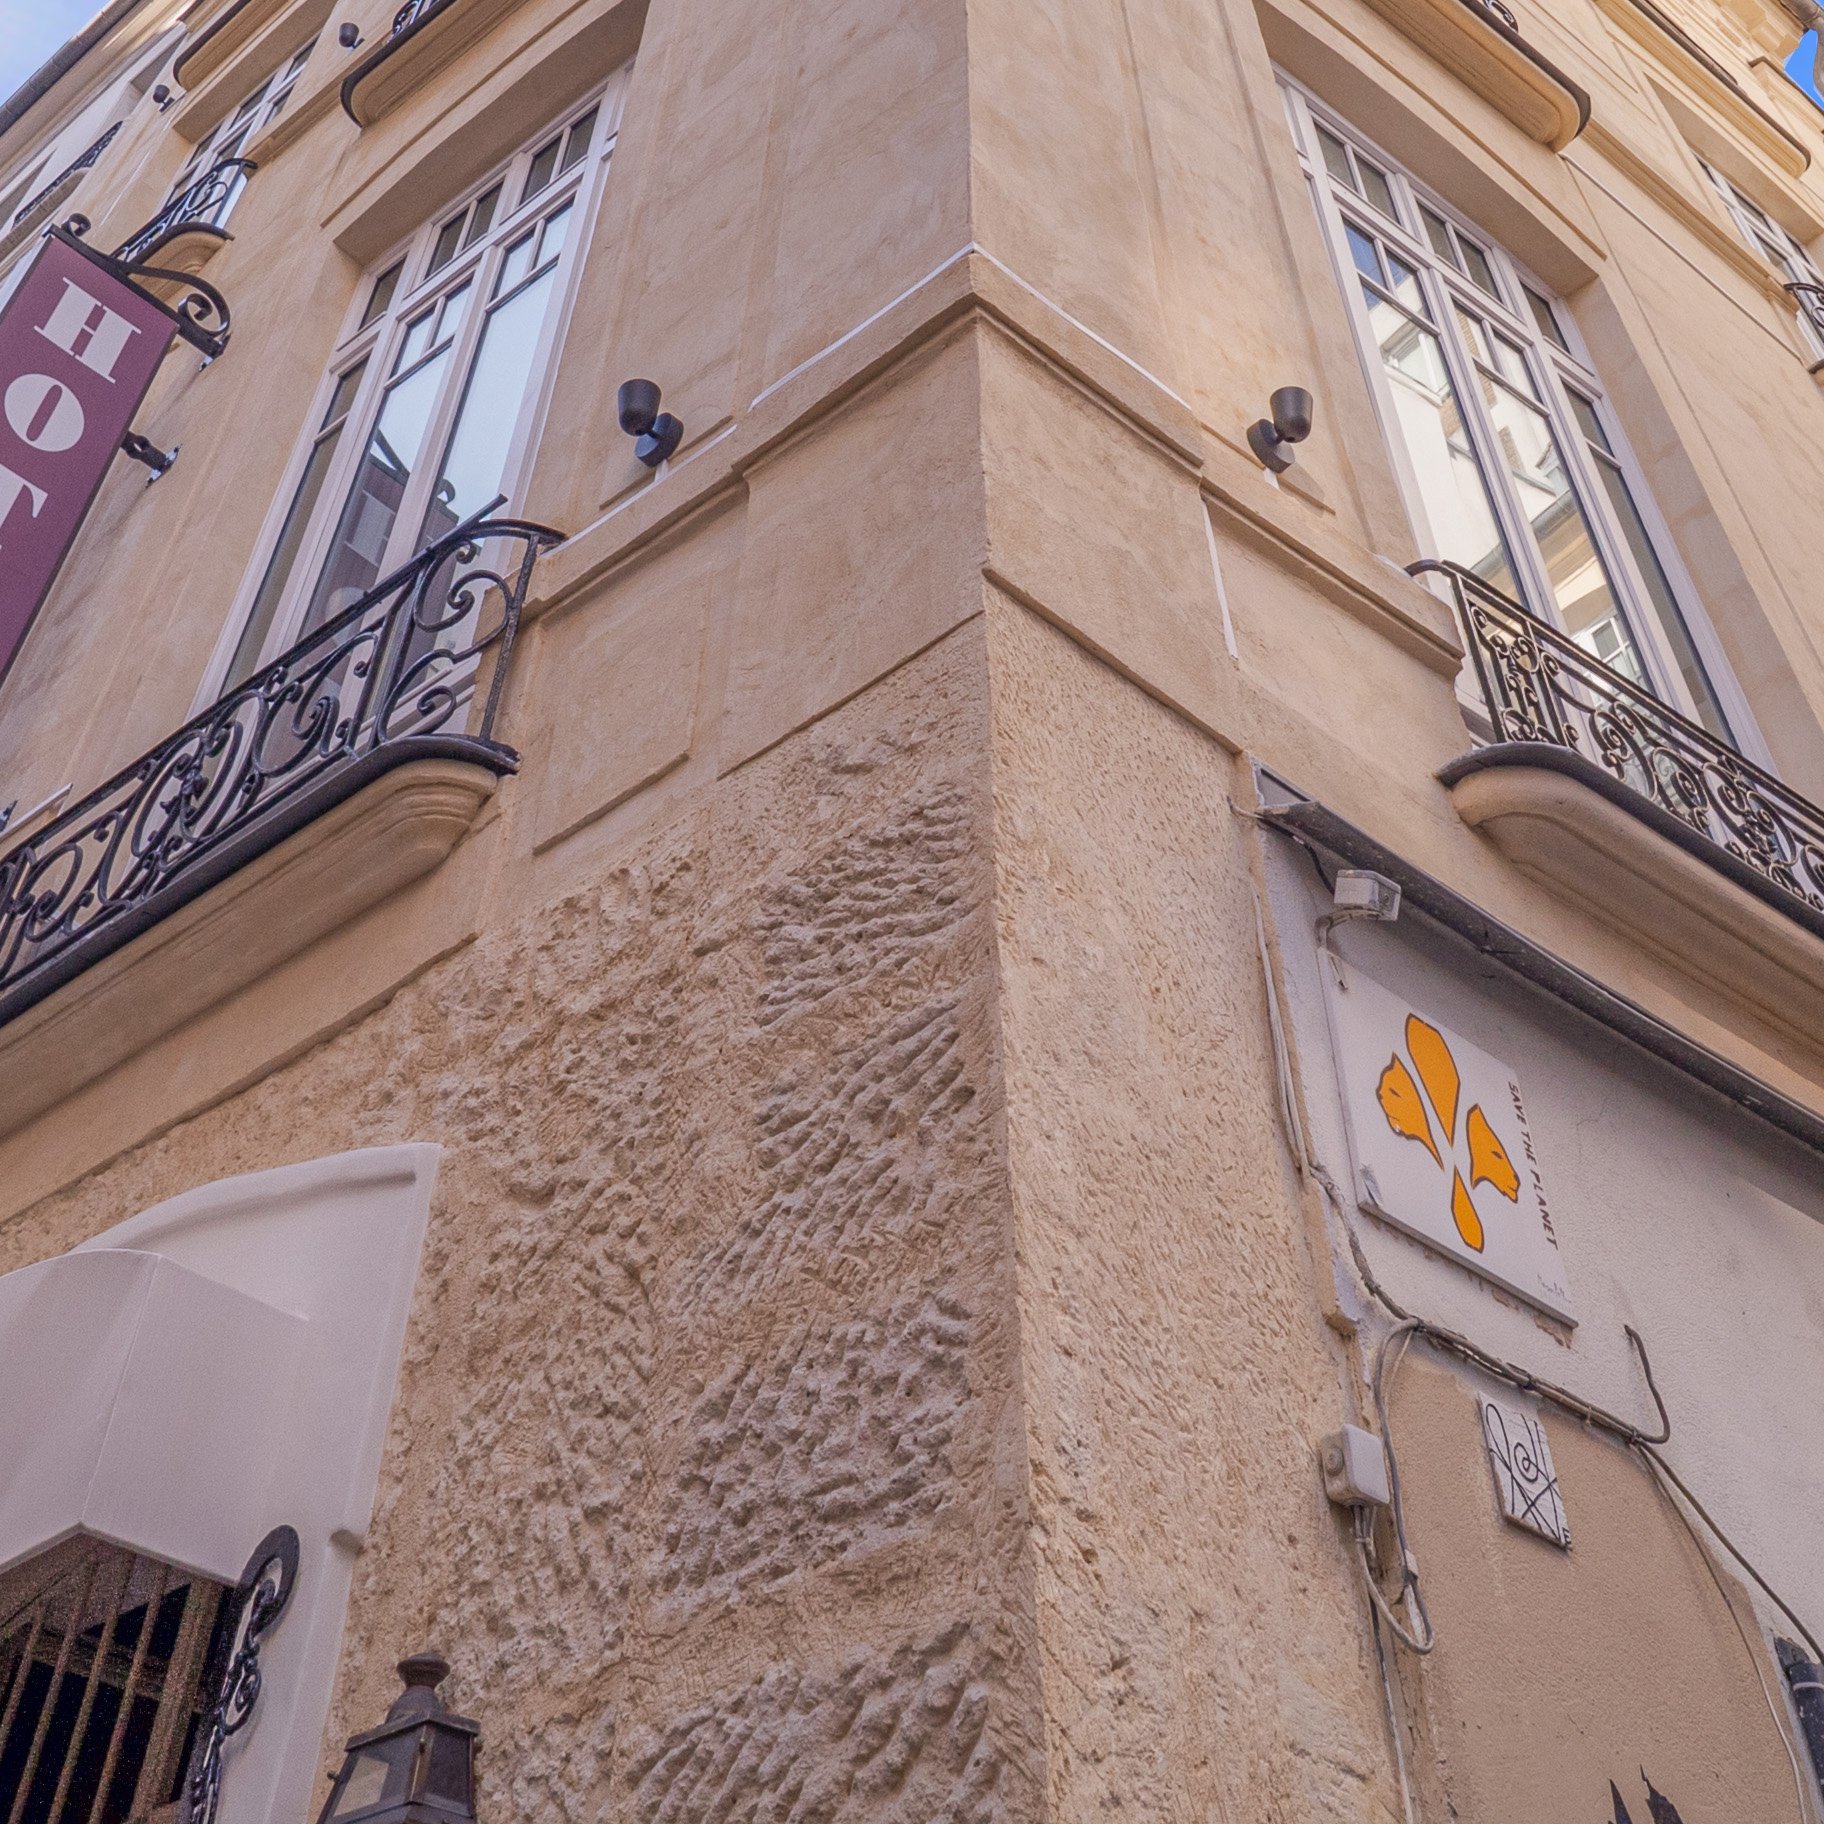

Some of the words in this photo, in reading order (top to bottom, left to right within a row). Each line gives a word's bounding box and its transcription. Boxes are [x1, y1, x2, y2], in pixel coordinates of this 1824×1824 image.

[1508, 1081, 1527, 1125] SAVE
[1521, 1131, 1537, 1166] THE
[1530, 1169, 1559, 1251] PLANET
